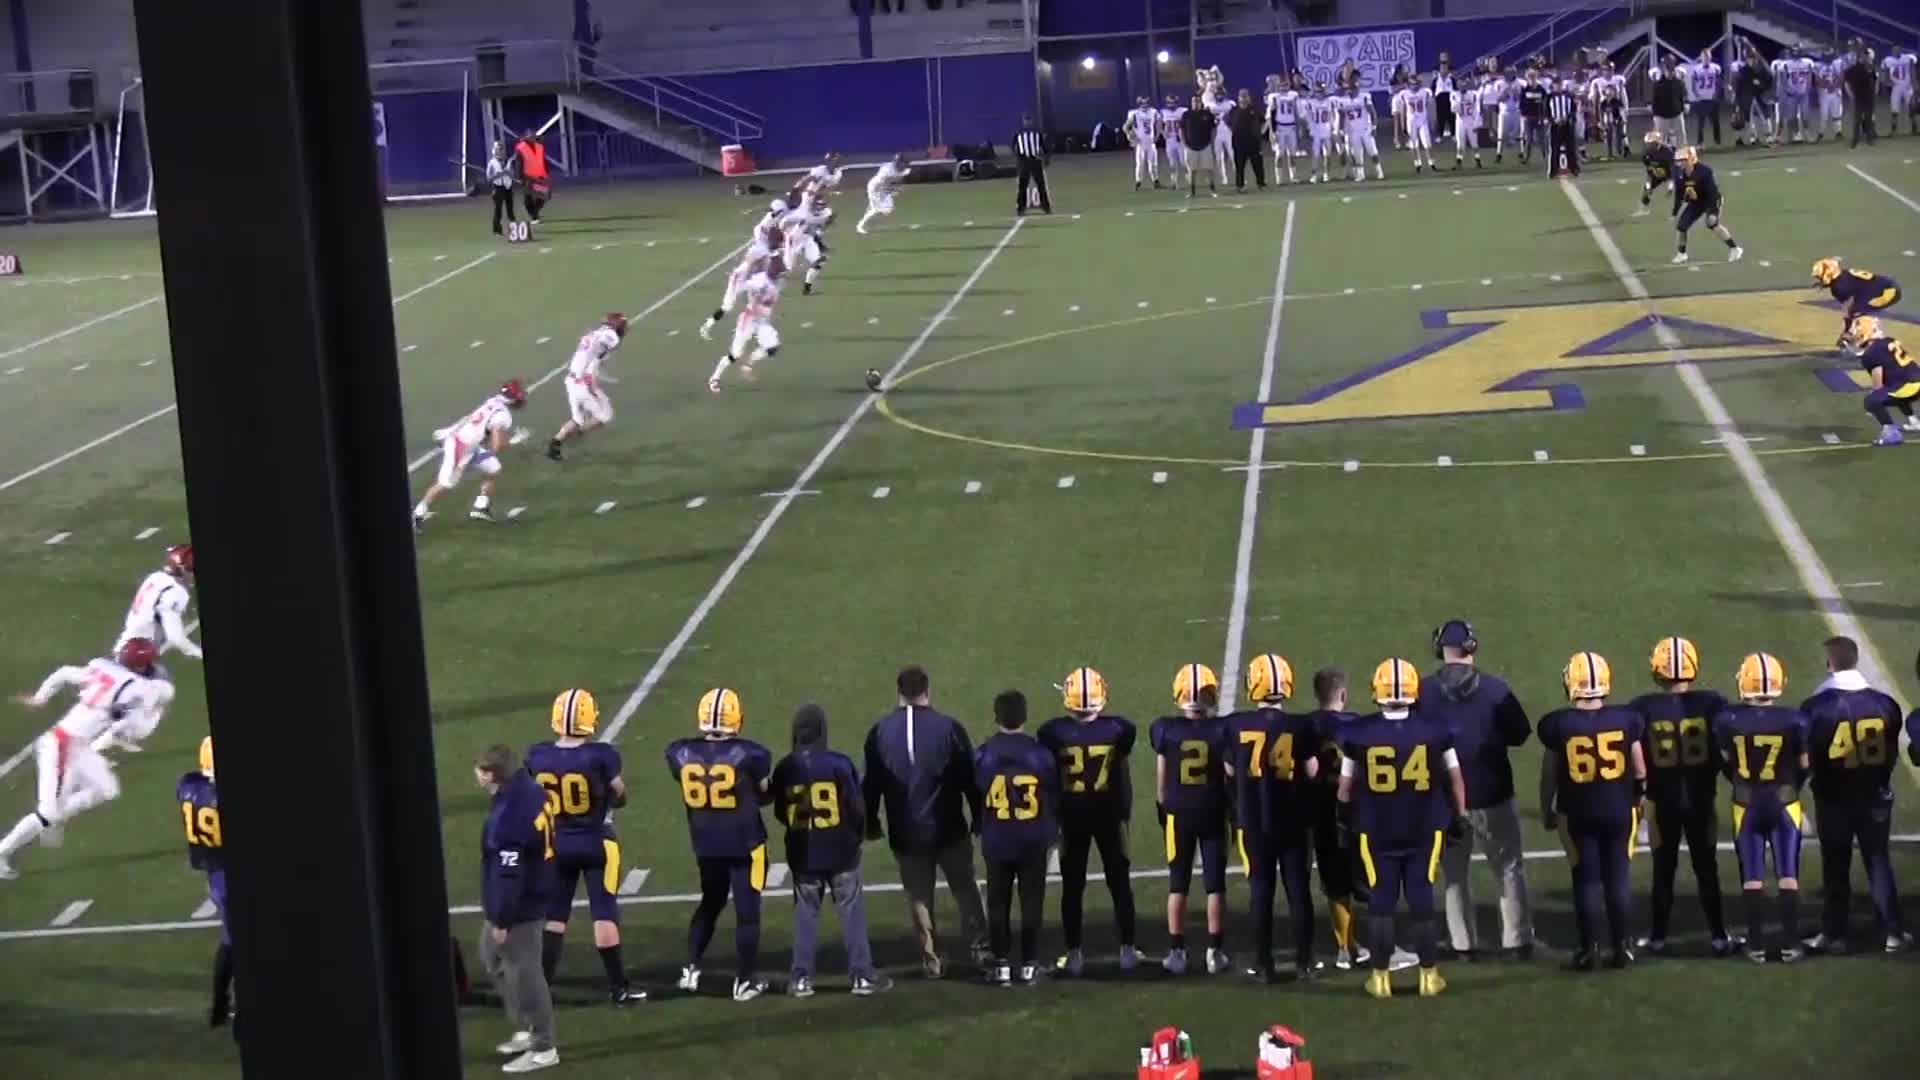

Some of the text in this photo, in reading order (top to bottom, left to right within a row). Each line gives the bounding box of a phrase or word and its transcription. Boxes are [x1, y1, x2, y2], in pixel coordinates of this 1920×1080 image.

[1303, 39, 1340, 64] GO
[1302, 64, 1411, 91] SOCE
[509, 221, 528, 241] 30
[1061, 744, 1115, 792] 27
[1179, 739, 1209, 785] 2
[1239, 730, 1295, 780] 74
[1366, 744, 1431, 793] 64
[1565, 730, 1626, 784] 65
[1733, 734, 1784, 781] 17
[680, 763, 737, 810] 62
[985, 774, 1039, 821] 43
[182, 801, 222, 847] 19
[499, 850, 519, 867] 72
